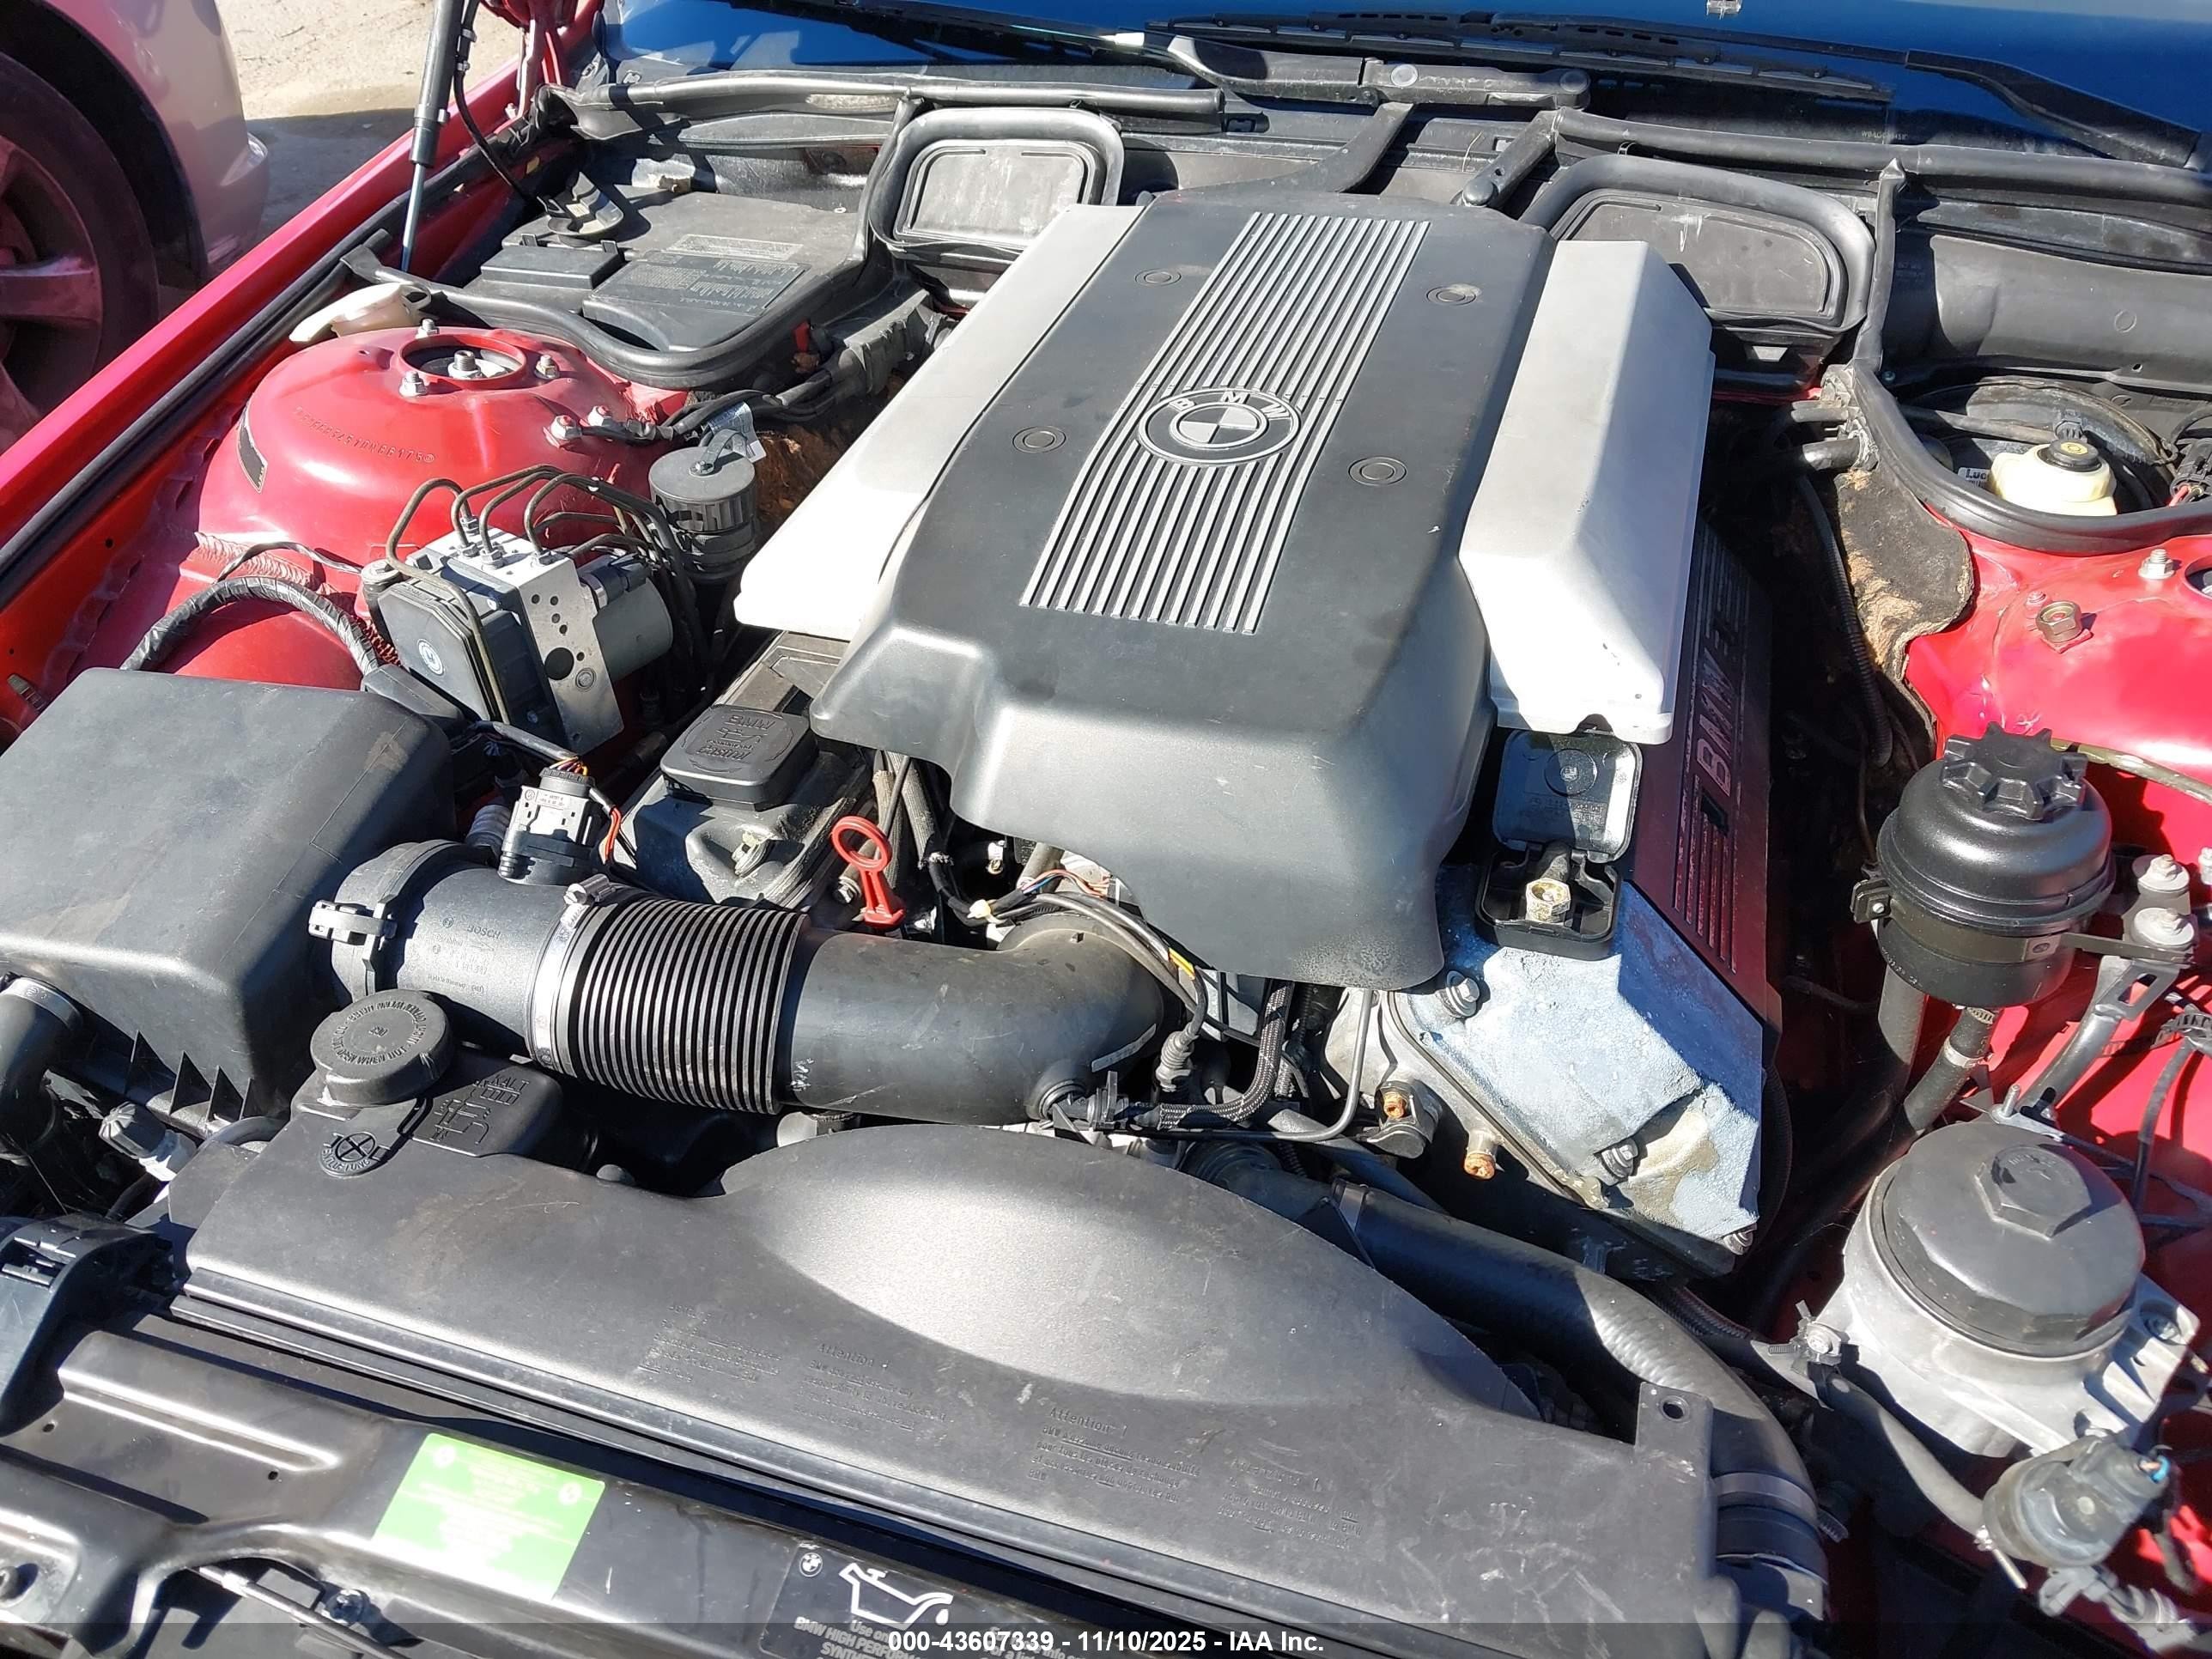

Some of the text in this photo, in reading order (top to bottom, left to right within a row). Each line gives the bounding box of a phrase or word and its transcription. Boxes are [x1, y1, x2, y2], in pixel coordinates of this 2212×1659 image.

[1168, 391, 1291, 419] BMW
[1697, 647, 1733, 797] BMW
[480, 1087, 520, 1106] COLD
[1049, 1407, 1110, 1435] Attention
[793, 1616, 827, 1638] BMW
[824, 1626, 858, 1649] HIGH
[850, 1618, 874, 1638] Use
